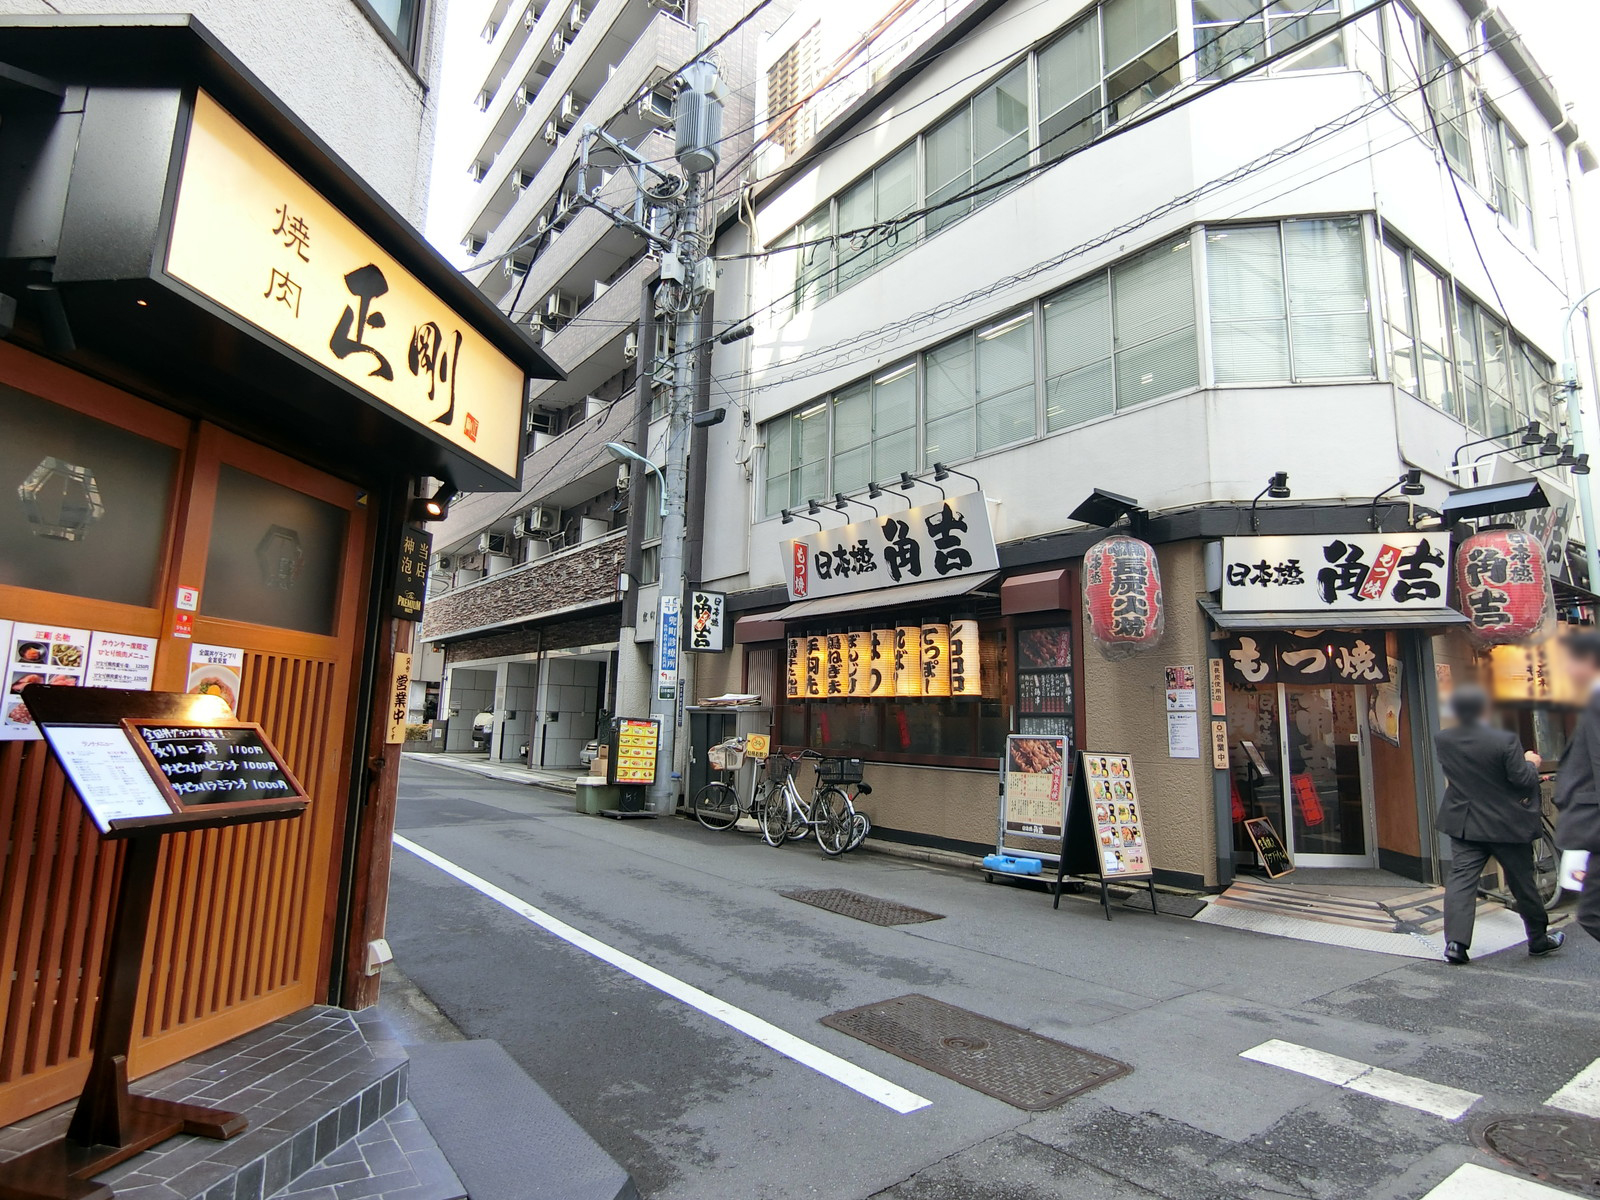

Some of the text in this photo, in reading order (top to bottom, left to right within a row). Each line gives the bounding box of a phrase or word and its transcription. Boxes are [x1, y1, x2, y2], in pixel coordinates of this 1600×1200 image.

[263, 203, 311, 318] 焼肉
[329, 262, 462, 426] 正剛
[401, 536, 416, 583] 神泡。
[416, 542, 429, 586] 当店、
[814, 502, 973, 583] 日本橋 角吉
[1506, 533, 1535, 583] 日本橋
[793, 546, 808, 598] もつ焼
[1226, 537, 1446, 605] 日本橋 角吉
[1362, 549, 1395, 599] もつ焼
[1466, 547, 1512, 628] 角吉
[397, 595, 422, 611] PREMIUM
[693, 592, 713, 648] 角吉
[807, 636, 820, 695] 手羽先
[828, 635, 843, 695] 鶏ねぎま
[1228, 636, 1385, 683] もつ焼
[393, 674, 409, 726] 営業中
[229, 744, 264, 754] 1100円
[243, 761, 278, 771] 1000円
[1215, 734, 1226, 762] 営業中
[252, 779, 289, 790] 1000円
